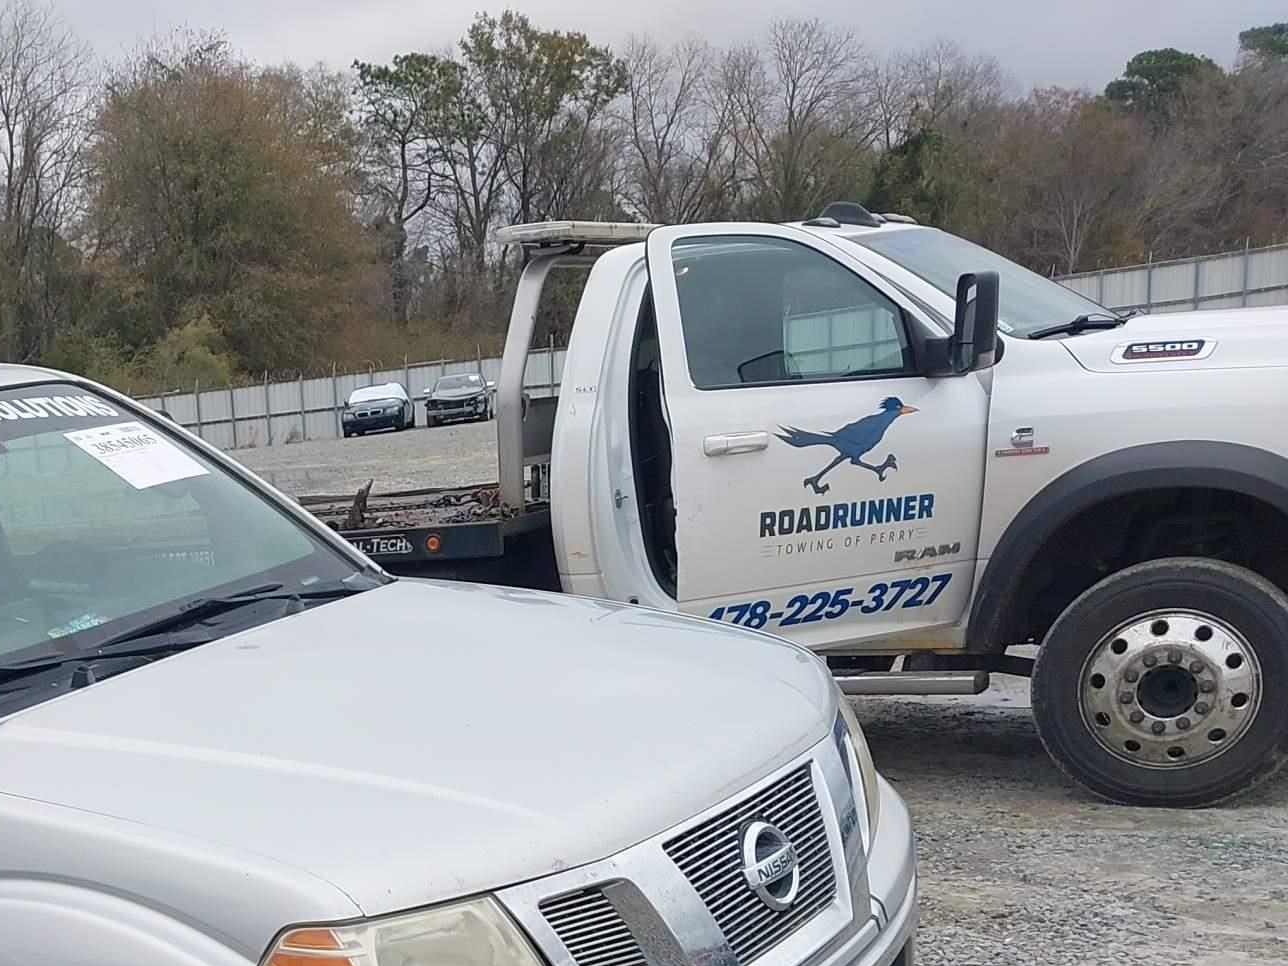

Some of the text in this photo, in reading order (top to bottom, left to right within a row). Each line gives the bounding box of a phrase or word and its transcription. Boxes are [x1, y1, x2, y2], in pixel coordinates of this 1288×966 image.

[1132, 342, 1199, 353] 5500
[91, 434, 159, 455] 38545065
[759, 493, 935, 538] ROADRUNNER
[776, 528, 915, 557] TOWING OF PERRY
[894, 541, 961, 562] RAM
